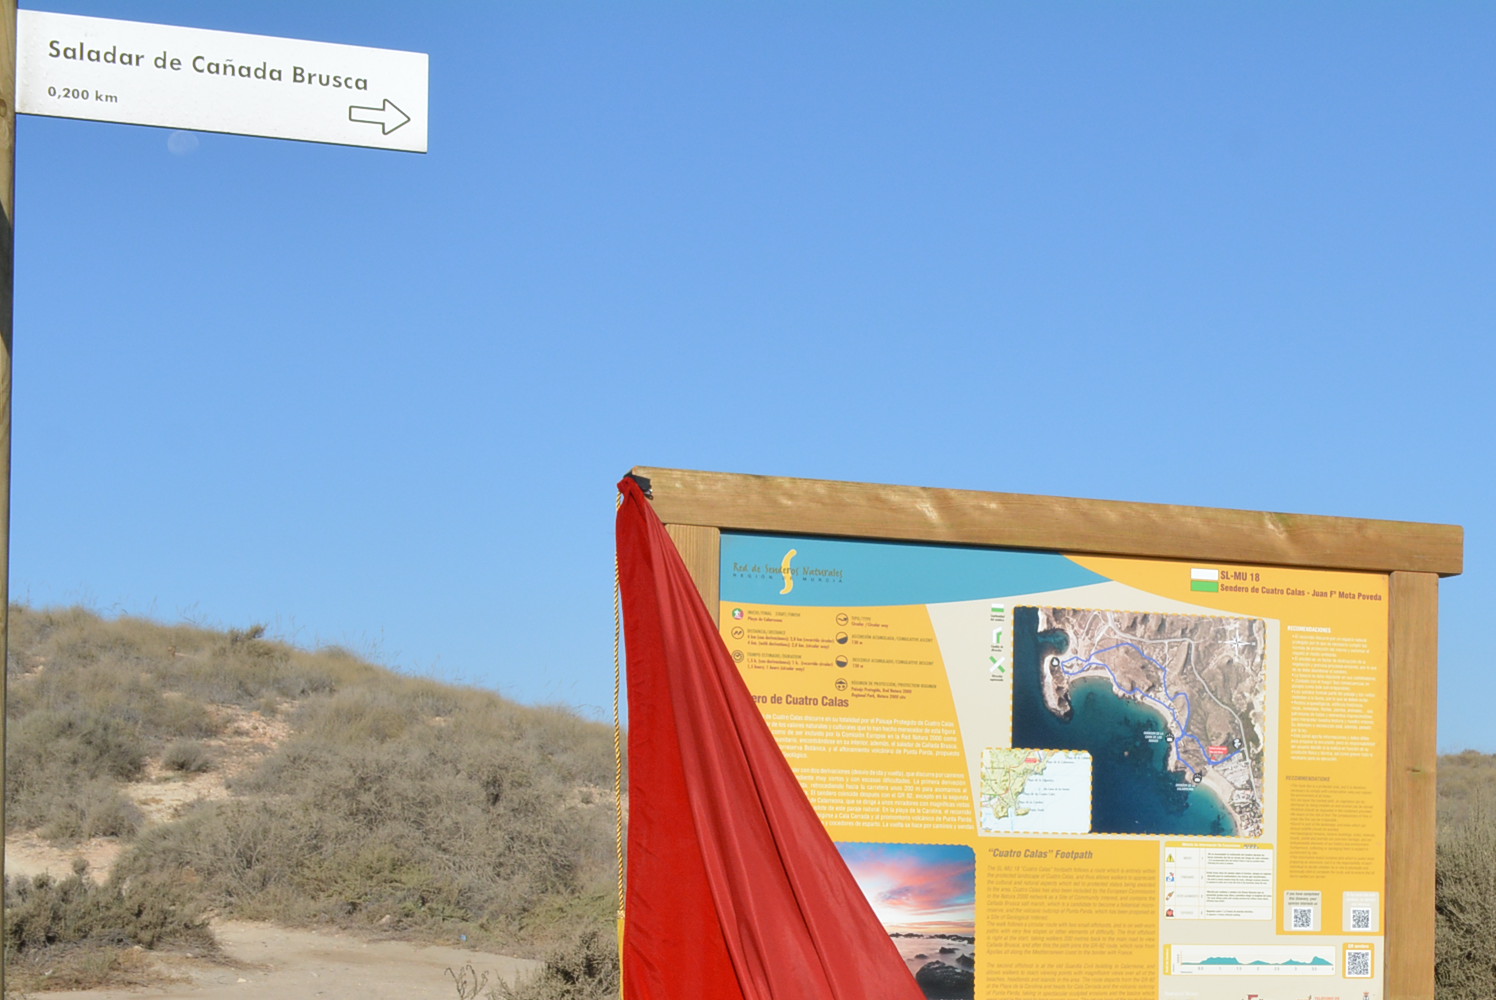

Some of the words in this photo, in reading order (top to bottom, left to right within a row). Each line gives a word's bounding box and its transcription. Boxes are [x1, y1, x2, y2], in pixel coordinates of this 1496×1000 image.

[48, 39, 146, 68] Saladar
[154, 50, 182, 71] de
[192, 55, 283, 82] Cañada
[292, 66, 369, 91] Brusca
[47, 86, 90, 102] 0,200
[94, 90, 118, 104] km
[1220, 570, 1248, 581] SL-MU
[1250, 572, 1260, 582] 18
[1220, 583, 1248, 593] Sendero
[1250, 585, 1260, 594] de
[1261, 586, 1285, 595] Cuatro
[1286, 587, 1305, 597] Calas
[1311, 588, 1327, 598] Juan
[1338, 590, 1355, 600] Mota
[1357, 591, 1382, 601] Poveda
[771, 694, 782, 704] de
[785, 694, 819, 706] Cuatro
[821, 696, 849, 707] Calas
[1055, 850, 1093, 860] Footpath
